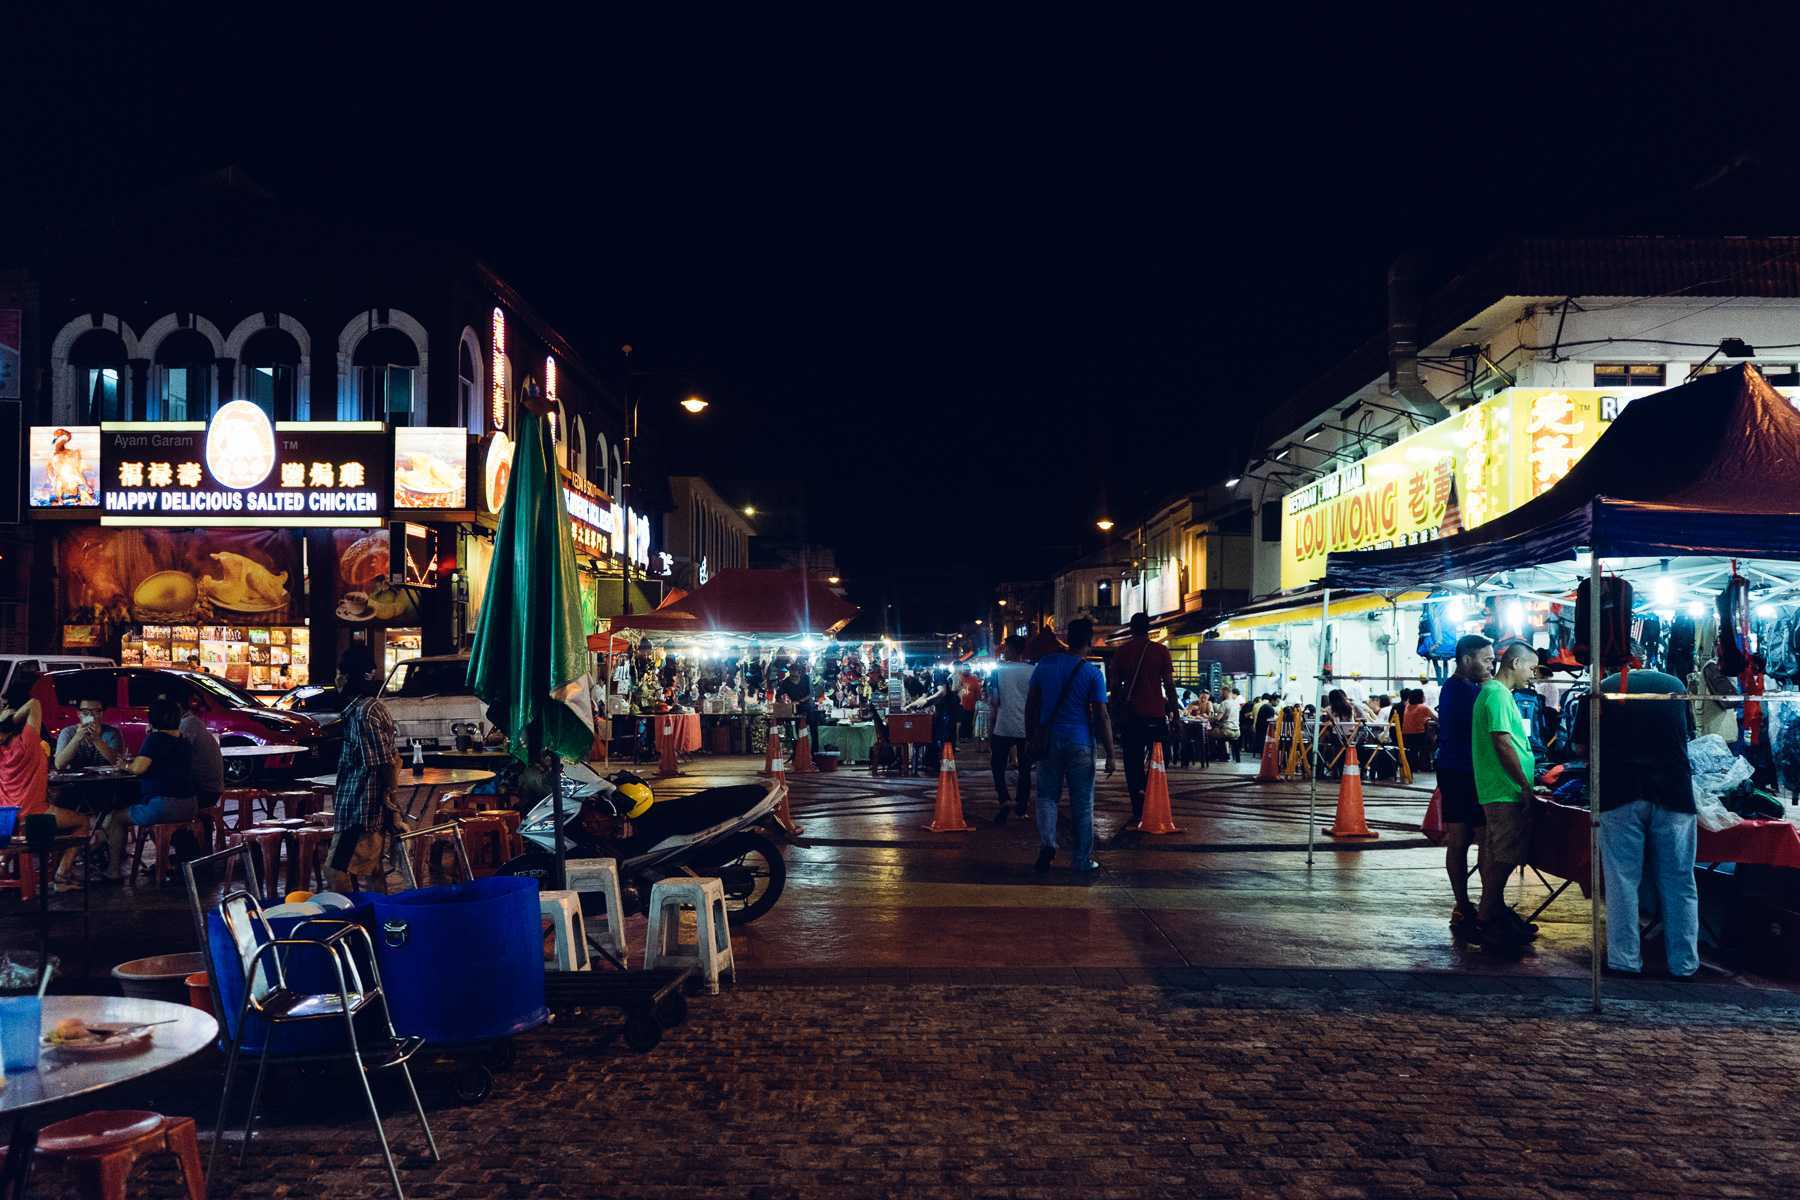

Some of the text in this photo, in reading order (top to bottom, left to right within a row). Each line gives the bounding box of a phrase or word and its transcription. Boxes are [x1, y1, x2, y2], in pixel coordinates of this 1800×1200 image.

[114, 434, 193, 449] Ayam Garam
[283, 441, 299, 449] TM
[106, 492, 378, 511] HAPPY DELICIOUS SALTED CHICKEN
[1295, 508, 1327, 560] LOU
[1331, 482, 1397, 548] WONG
[1408, 462, 1453, 520] 老黃
